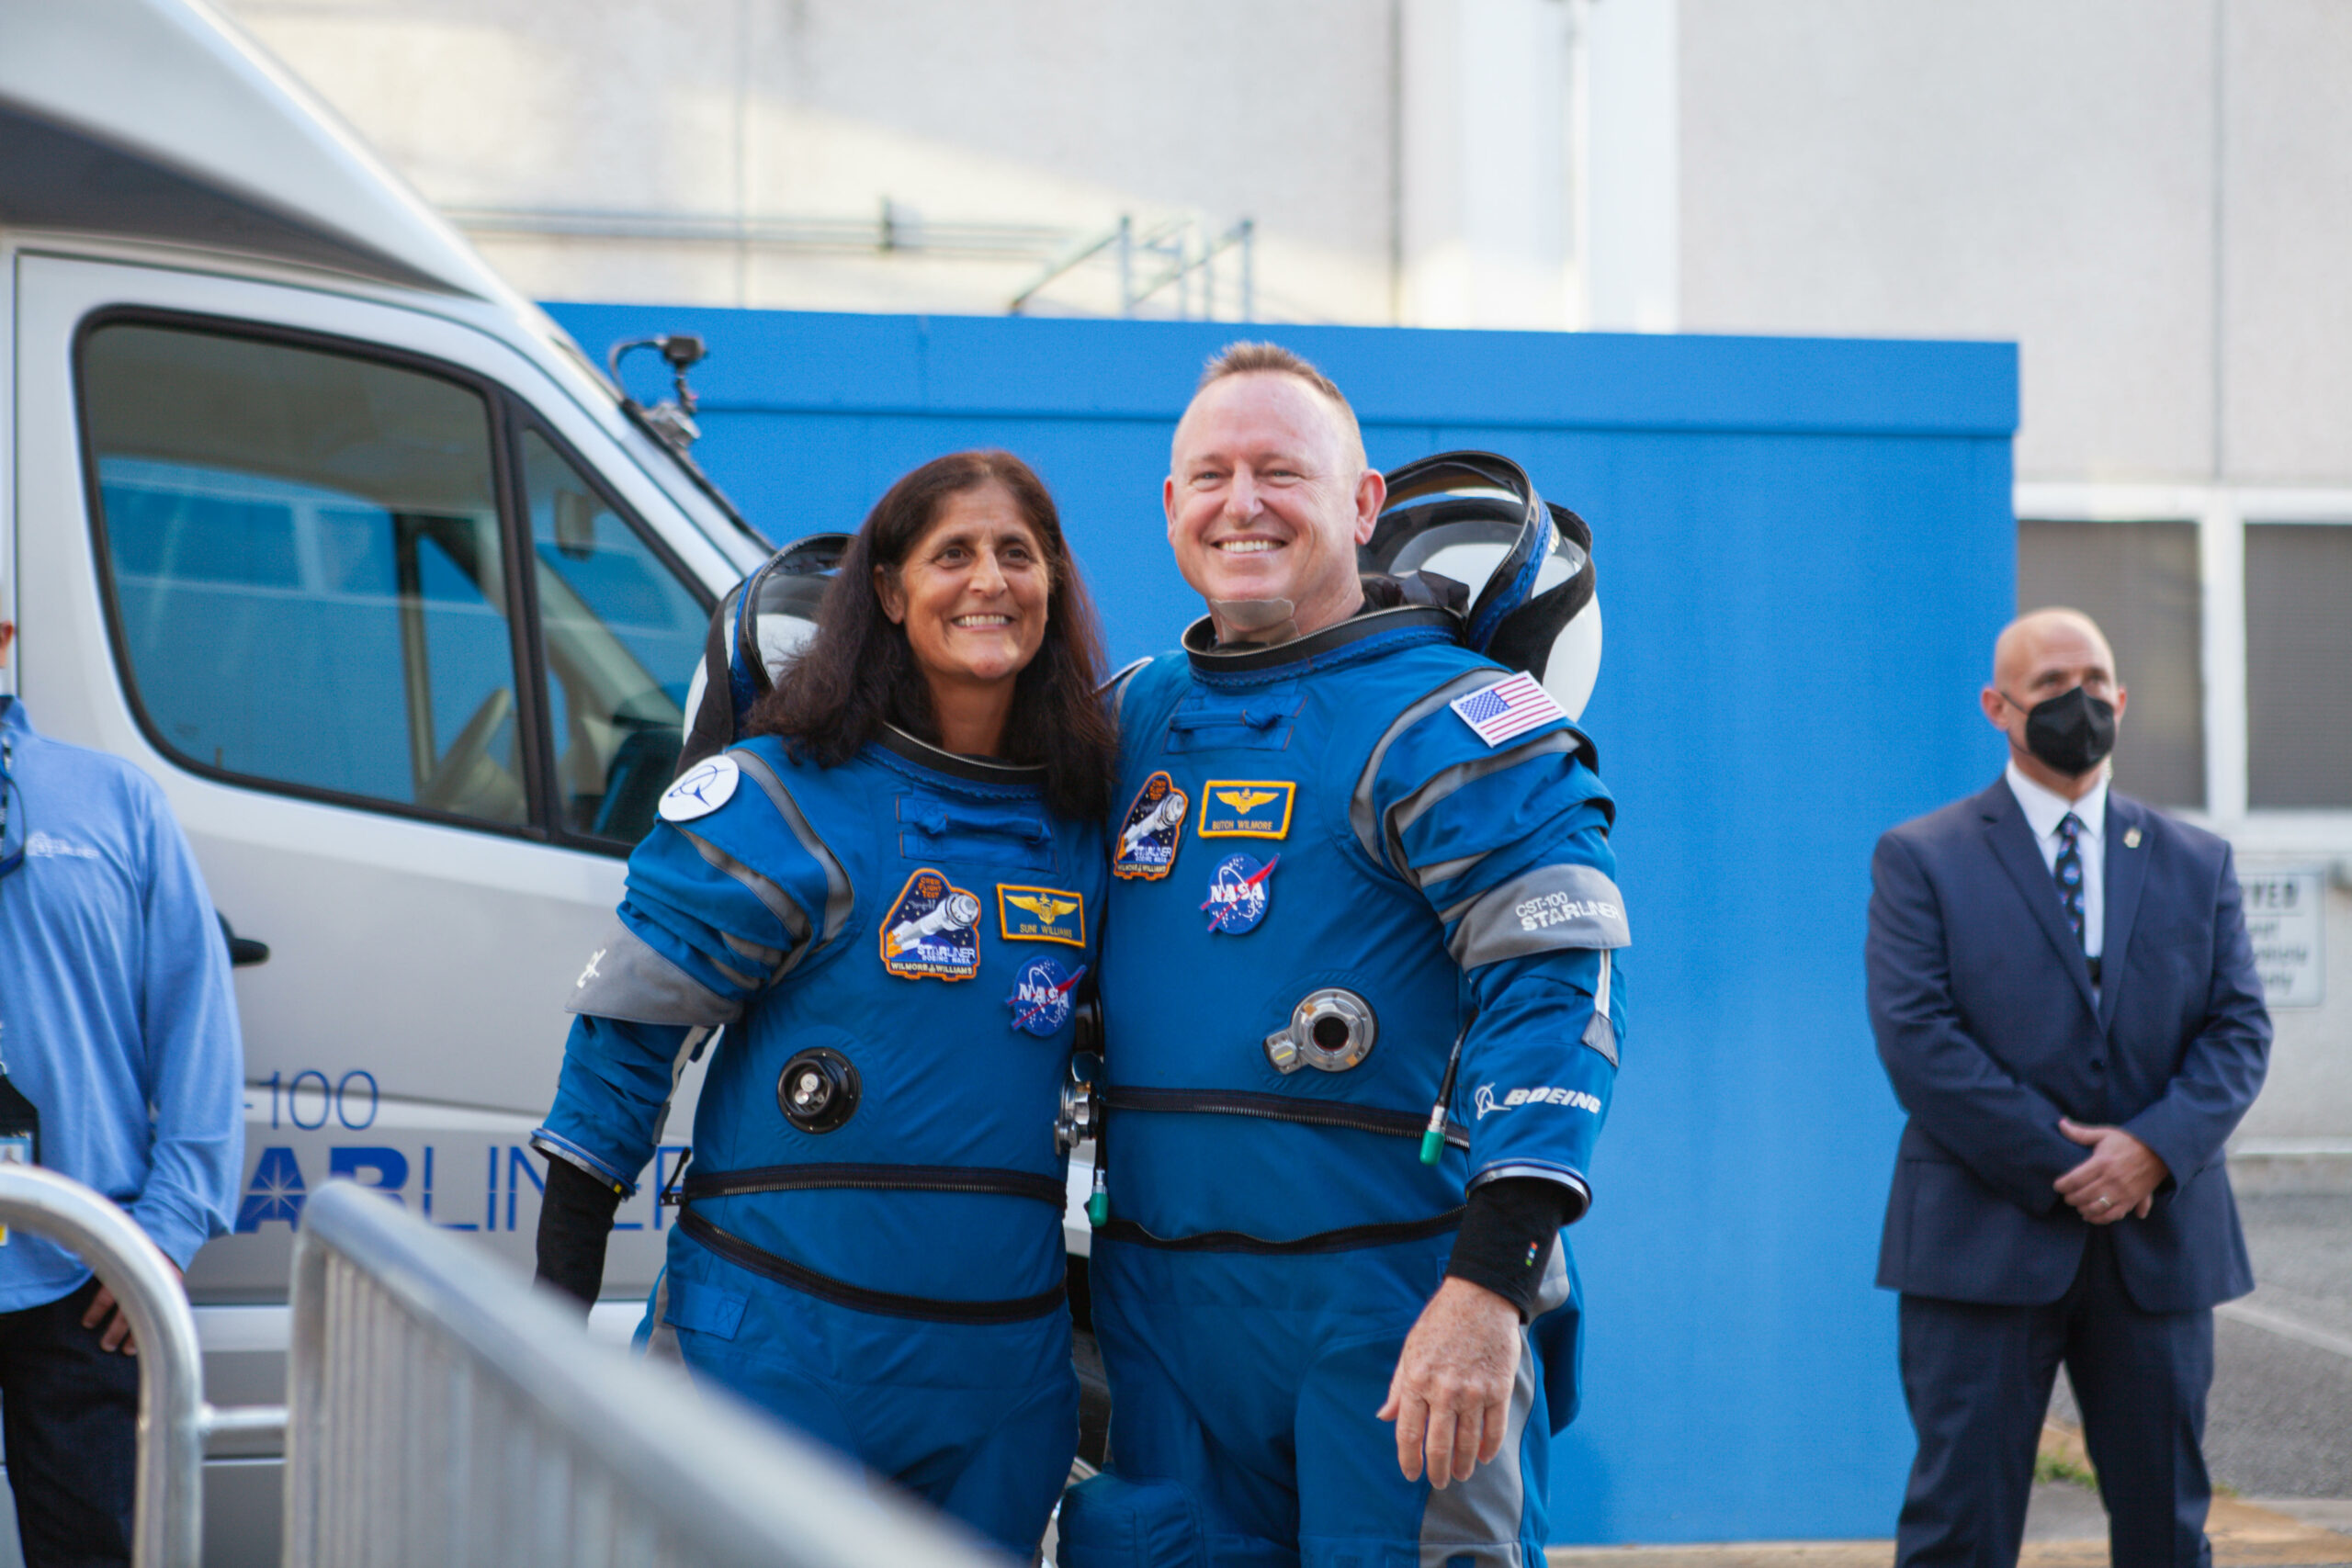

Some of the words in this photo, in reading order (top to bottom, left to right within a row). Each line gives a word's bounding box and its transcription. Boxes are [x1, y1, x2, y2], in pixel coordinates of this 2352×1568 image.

[1212, 820, 1234, 830] BUTCH
[1238, 820, 1273, 831] WILMORE
[1210, 882, 1266, 904] NASA
[1516, 891, 1568, 918] CST-100
[1521, 900, 1623, 931] STARLINER
[1020, 923, 1037, 934] SUNI
[1041, 925, 1072, 938] WILLIAMS
[917, 944, 975, 959] STARLINER
[890, 962, 928, 971] WILMORE
[935, 964, 973, 975] WILLIAMS
[1018, 983, 1069, 1010] NASA
[243, 1070, 379, 1131] -100
[1504, 1086, 1601, 1114] BOEING
